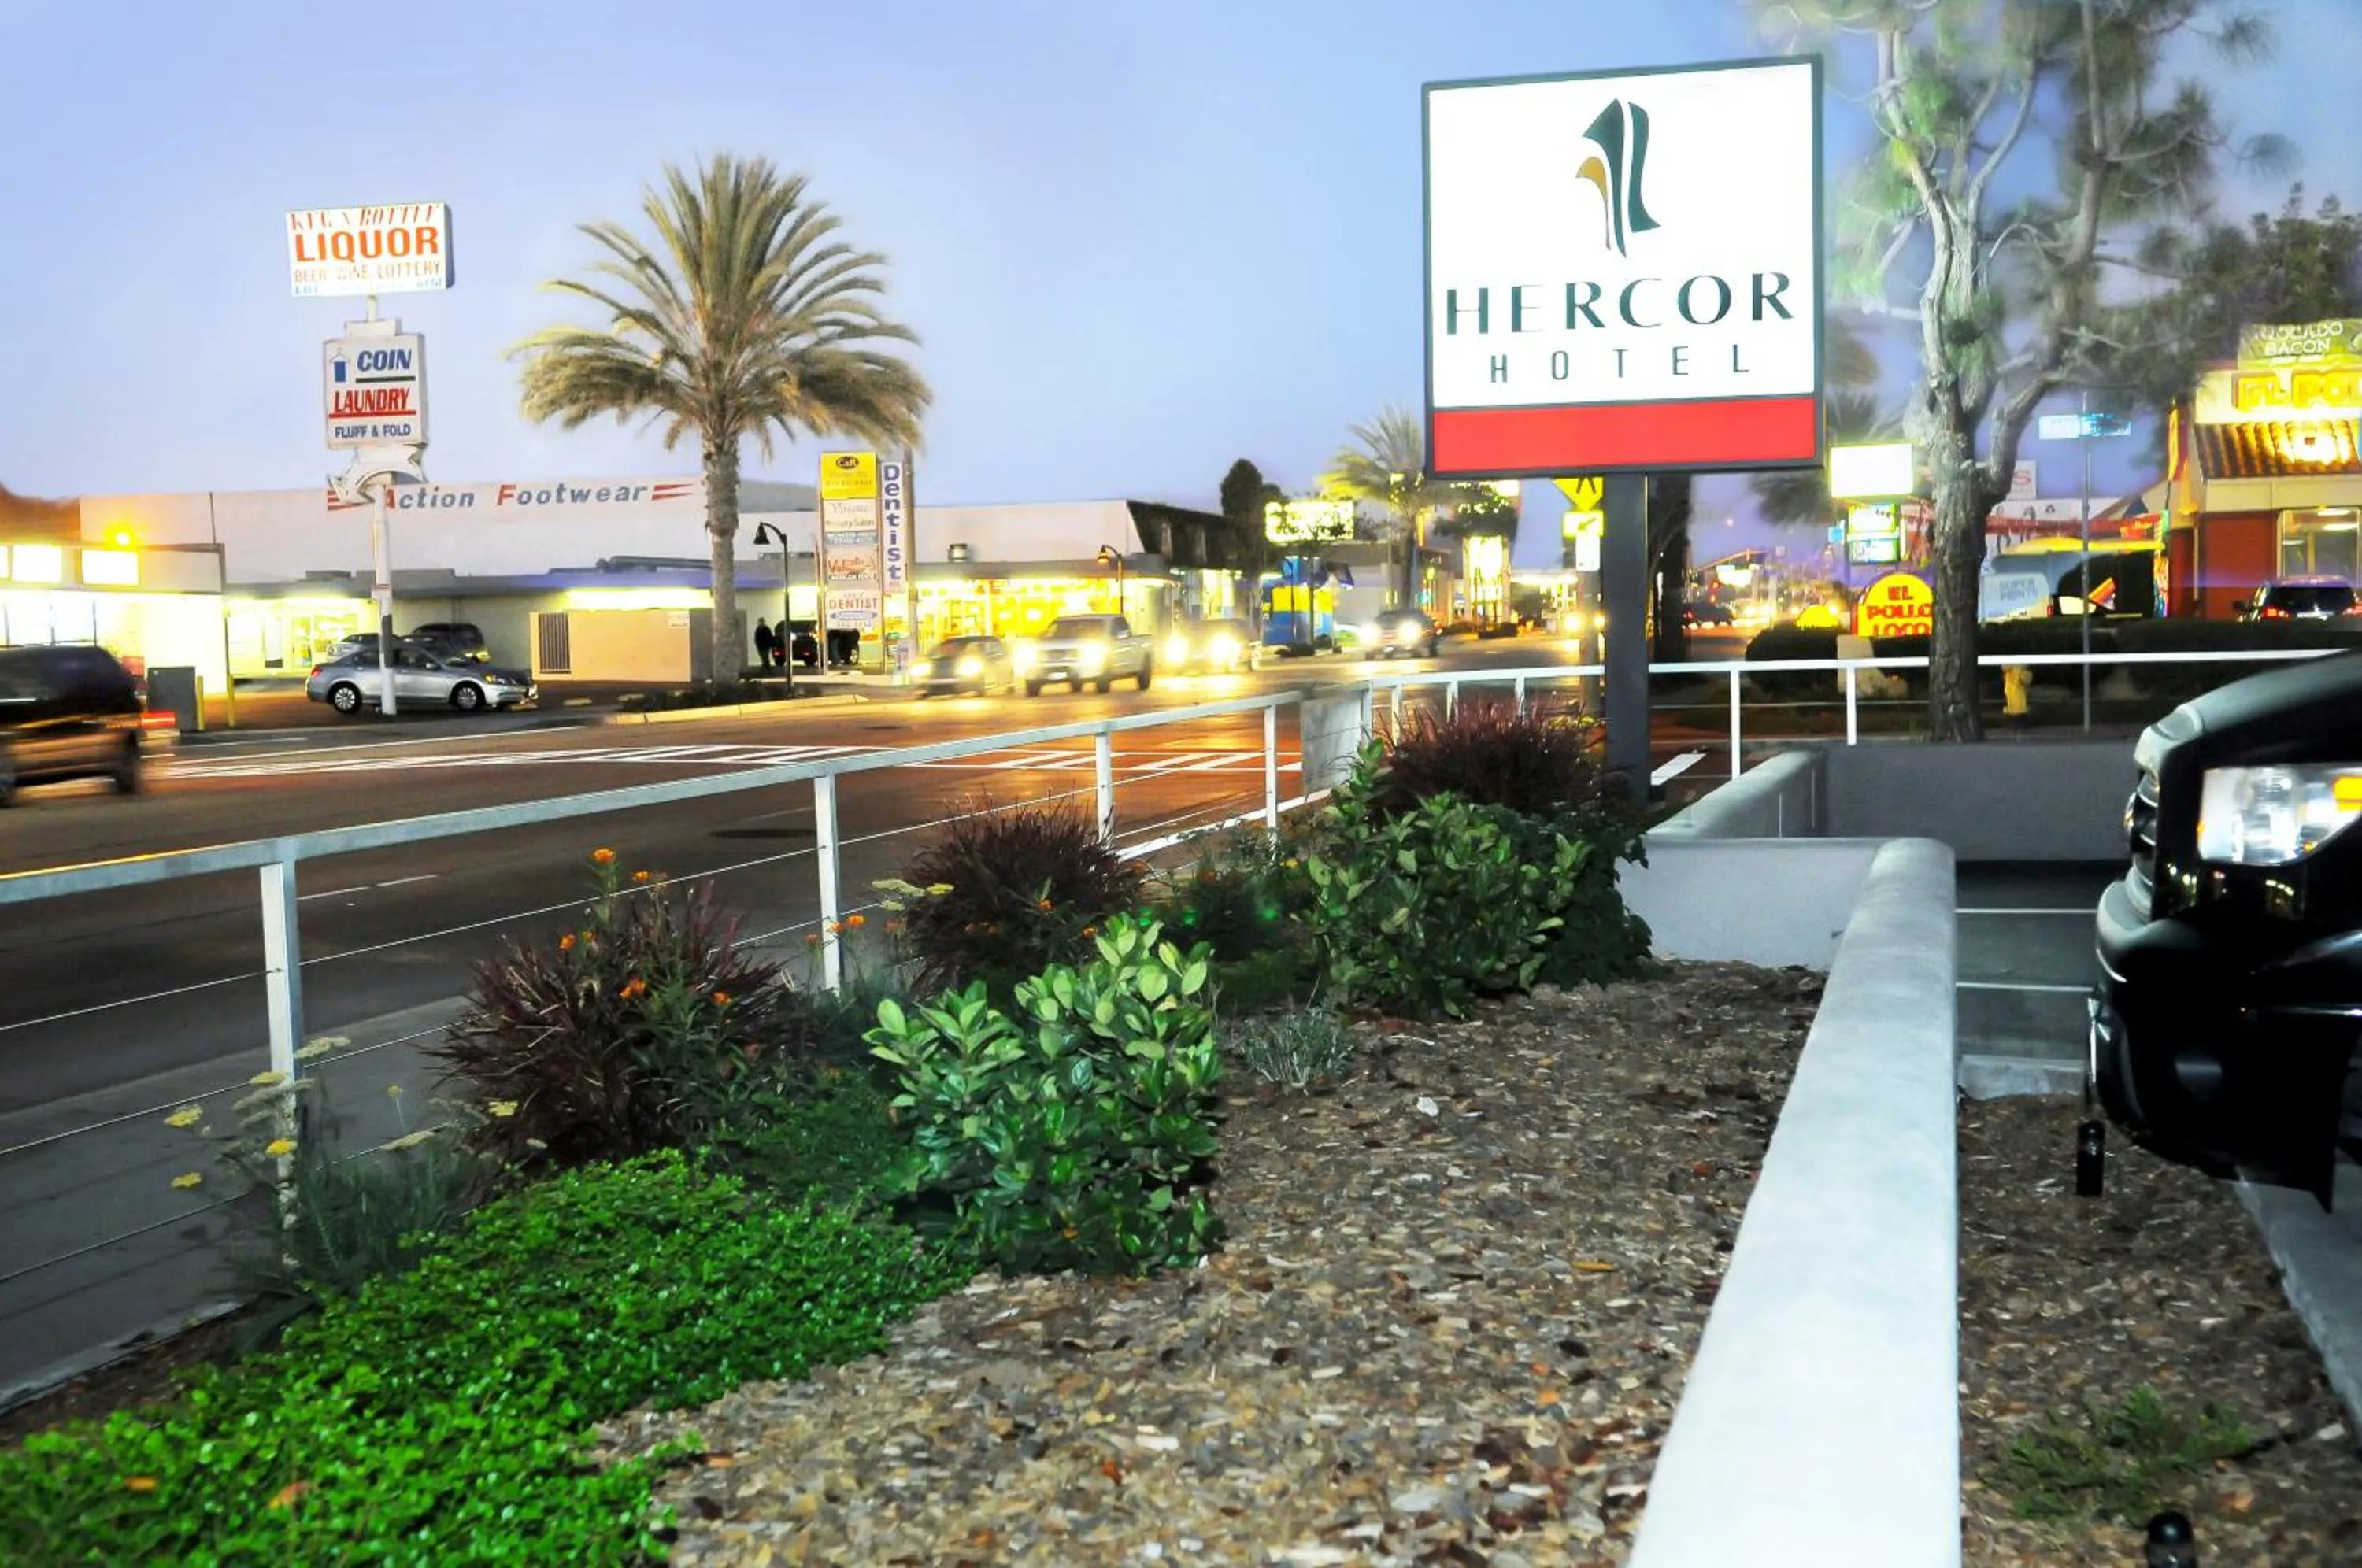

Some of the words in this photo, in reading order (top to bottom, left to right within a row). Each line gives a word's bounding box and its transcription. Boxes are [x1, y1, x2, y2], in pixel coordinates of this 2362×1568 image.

[295, 226, 439, 263] LIQUOR
[294, 268, 327, 283] BEER
[378, 261, 442, 279] LOTTERY
[1446, 272, 1794, 335] HERCOR
[357, 348, 413, 372] COIN
[1490, 344, 1749, 383] HOTEL
[334, 387, 410, 412] LAUNDRY
[335, 425, 368, 438] FLUFF
[371, 424, 379, 438] &
[383, 423, 412, 436] FOLD
[497, 483, 648, 505] Footwear
[883, 465, 901, 580] Dentist
[829, 597, 878, 610] DENTIST
[1888, 586, 1914, 601] EL
[1866, 604, 1932, 620] POLLO
